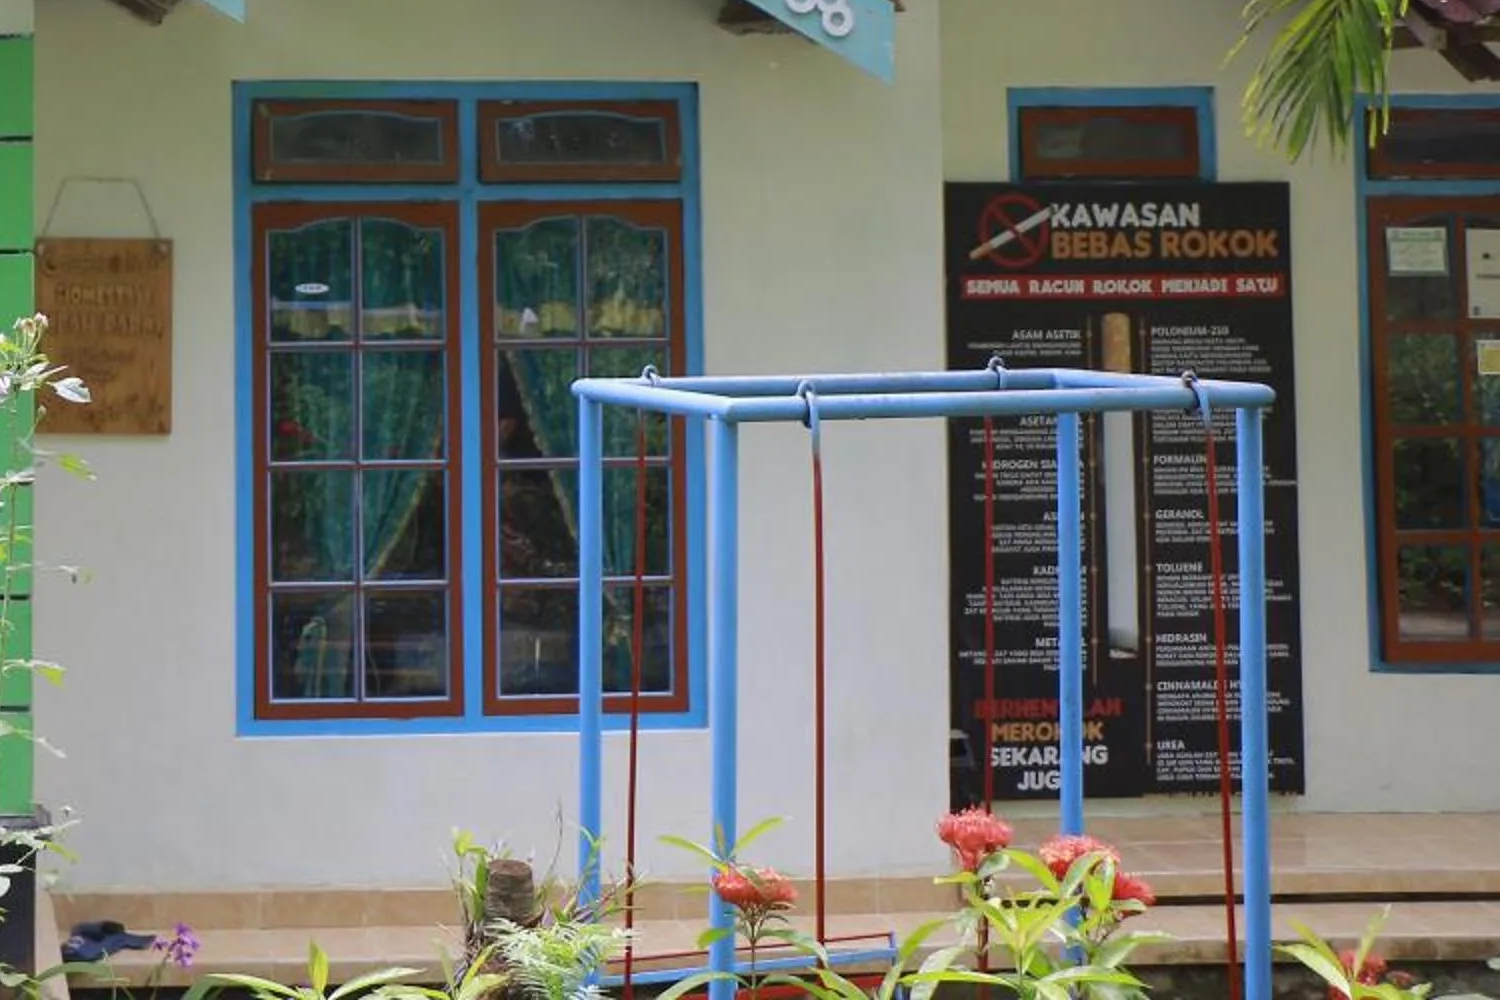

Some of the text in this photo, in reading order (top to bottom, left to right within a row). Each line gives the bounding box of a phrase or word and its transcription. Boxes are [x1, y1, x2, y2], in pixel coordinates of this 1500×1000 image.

[1050, 202, 1200, 228] KAWASAN
[1051, 229, 1279, 260] BEBAS ROKOK
[966, 277, 1280, 295] SEMUA RACUN ROKOK MENJADI SATU
[991, 722, 1104, 742] MEROK
[990, 746, 1109, 767] SEKARNG
[1017, 770, 1062, 791] JUG
